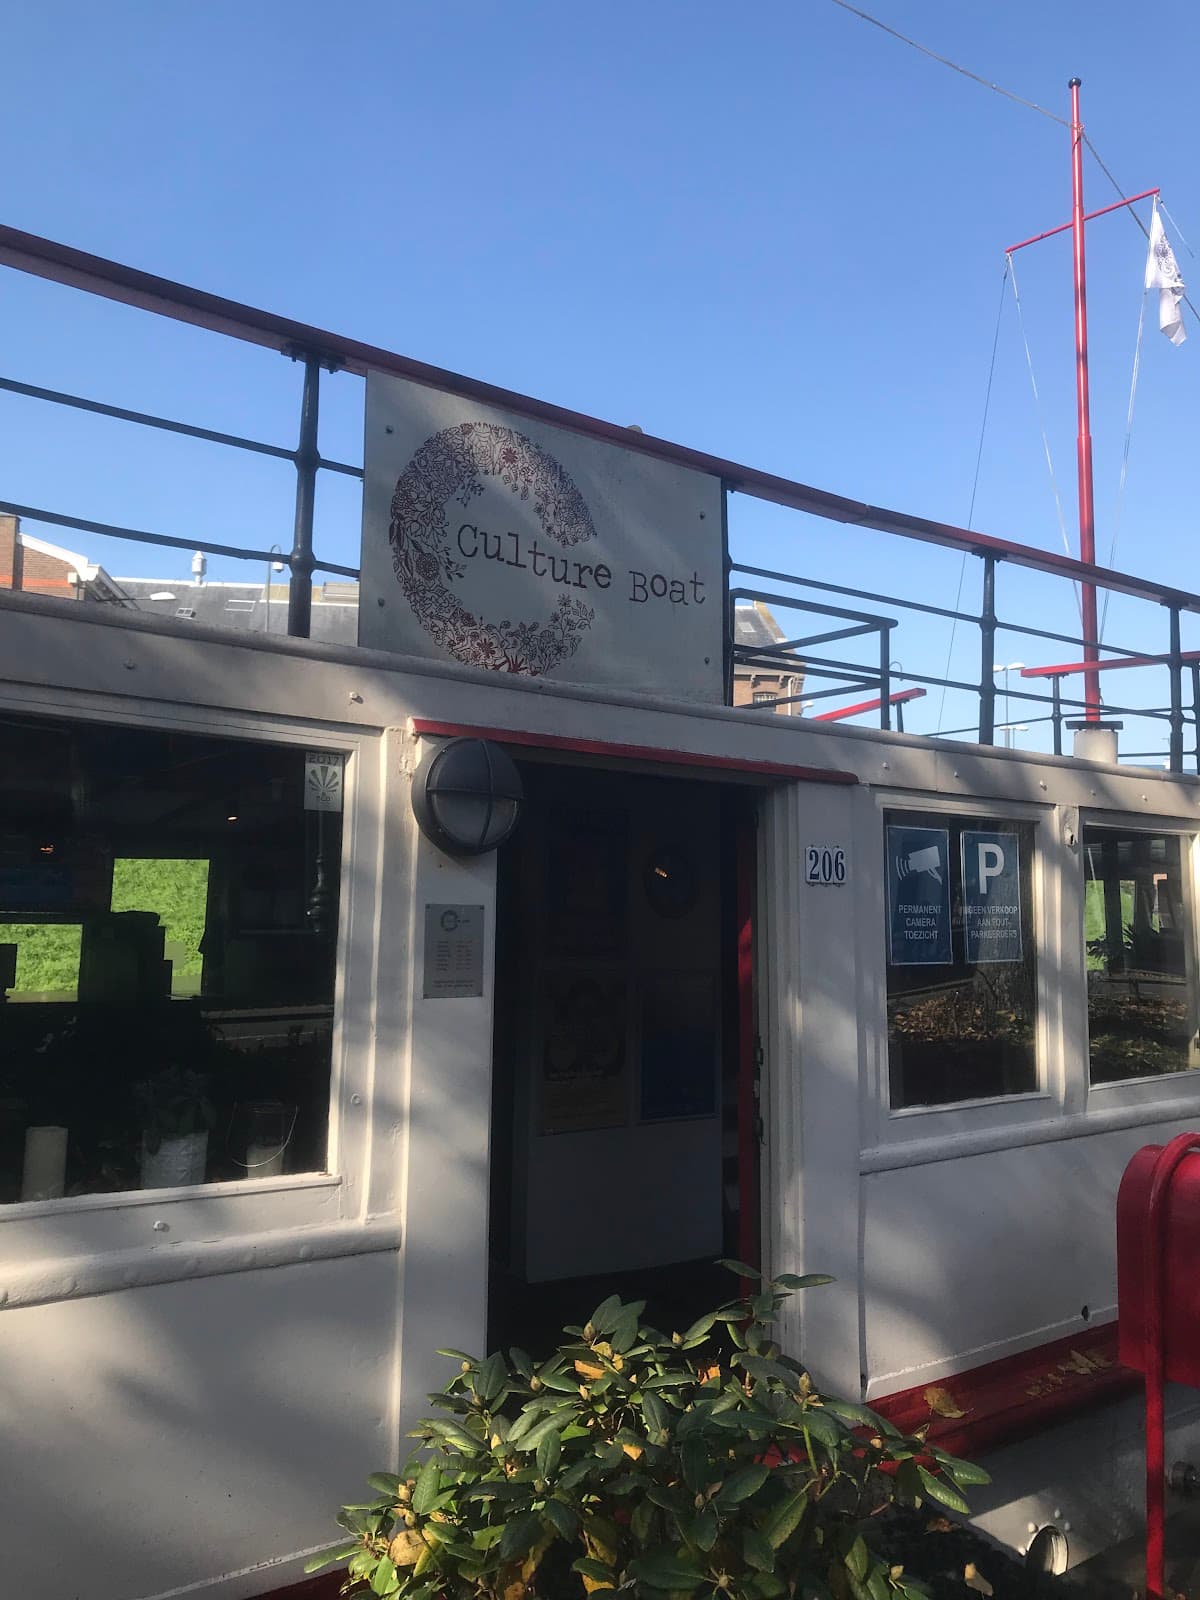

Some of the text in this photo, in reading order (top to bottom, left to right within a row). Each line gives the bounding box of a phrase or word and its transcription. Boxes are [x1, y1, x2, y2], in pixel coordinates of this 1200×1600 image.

[457, 523, 706, 606] Culture Boat
[808, 849, 846, 882] 206
[977, 842, 1005, 895] P
[898, 904, 942, 915] PERMANENT
[967, 905, 1018, 915] GEEN VERKOOP
[905, 917, 937, 927] CAMERA
[977, 918, 991, 927] AAN
[903, 930, 939, 940] TOEZICHT
[970, 930, 1018, 939] PARKEERDERS
